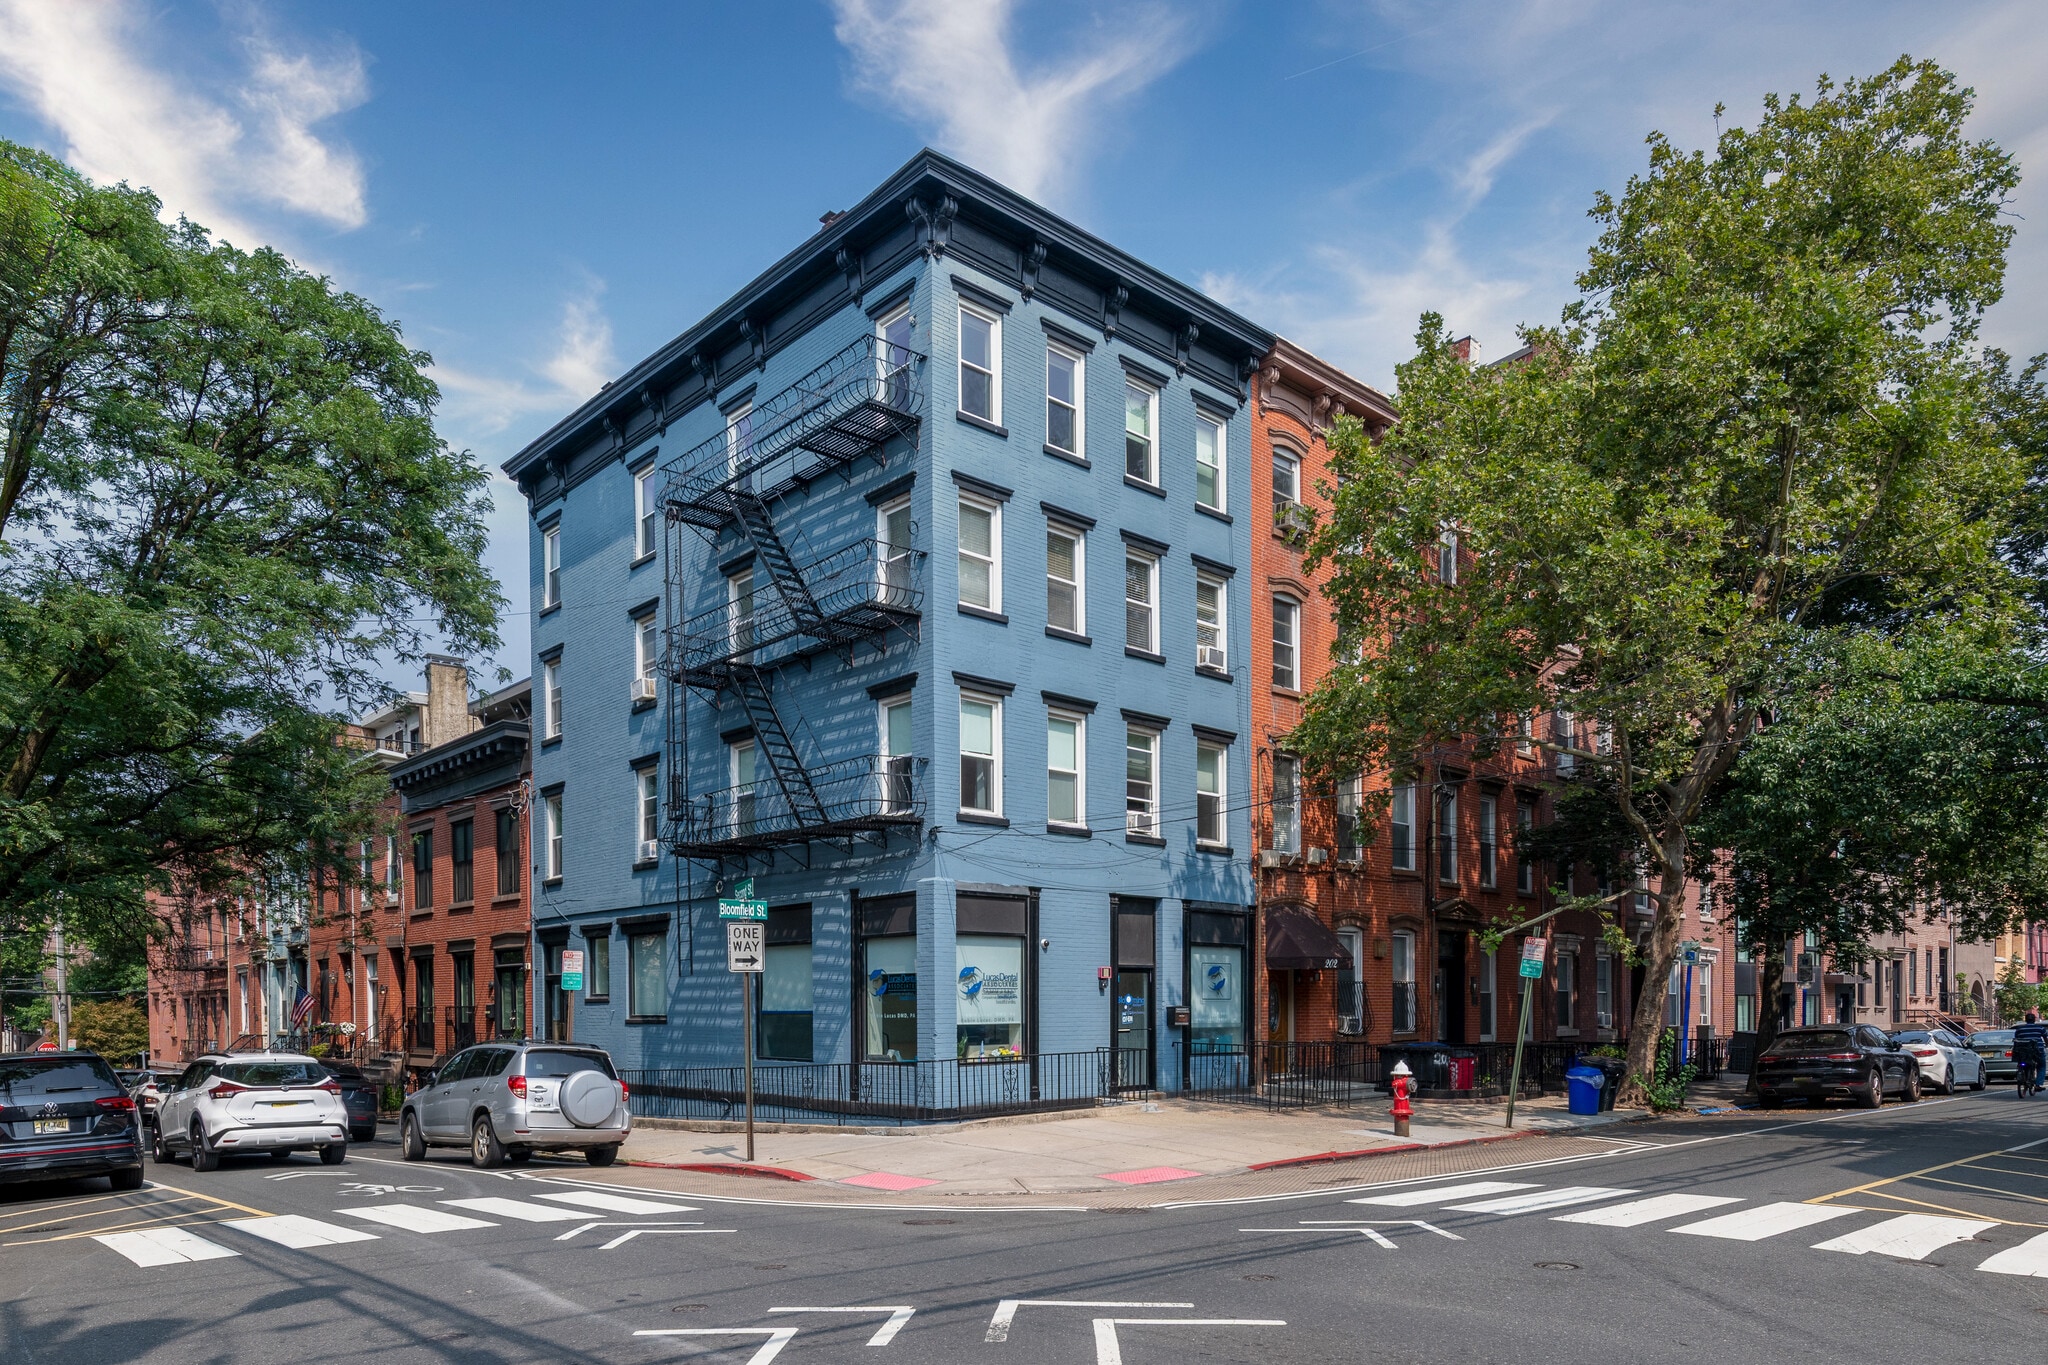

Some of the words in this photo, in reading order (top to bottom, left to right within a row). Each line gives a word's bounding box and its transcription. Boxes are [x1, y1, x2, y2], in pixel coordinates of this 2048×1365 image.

[720, 903, 755, 916] Bloomfield
[733, 927, 759, 939] ONE
[733, 941, 760, 952] WAY
[1325, 959, 1338, 968] 202
